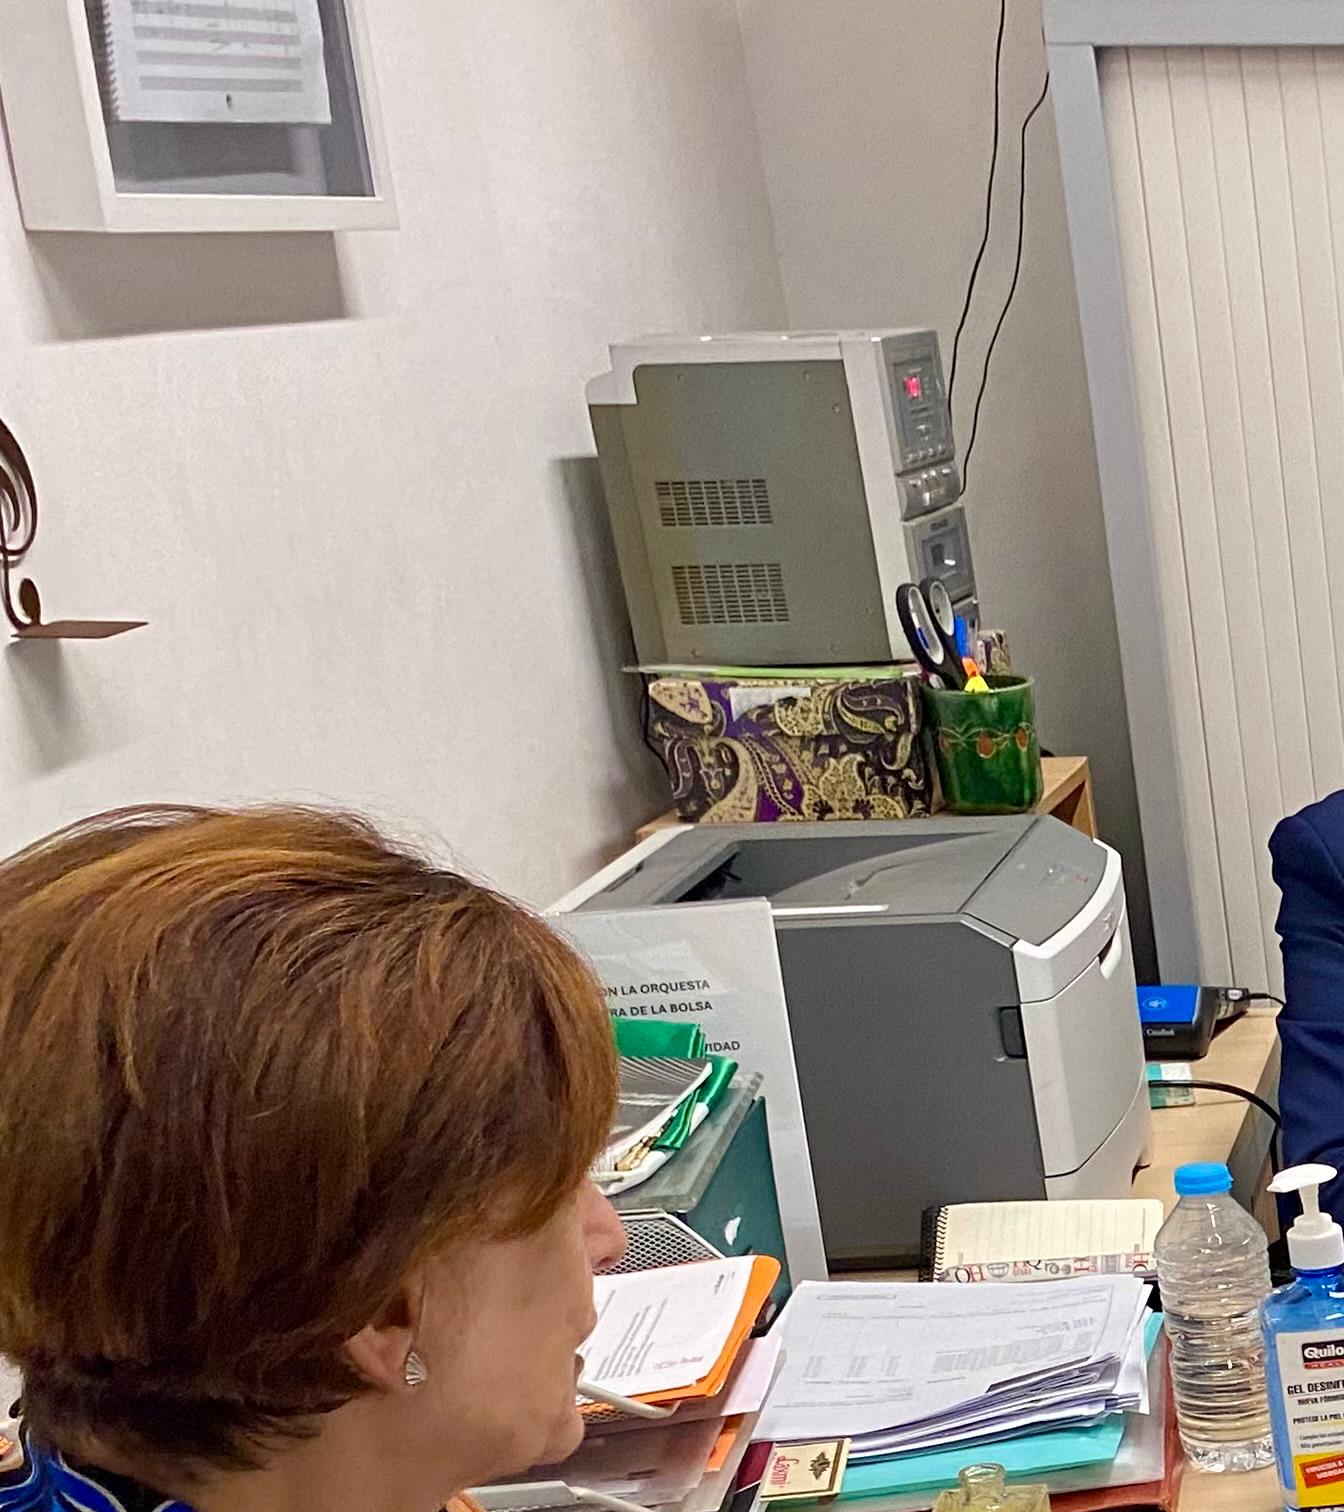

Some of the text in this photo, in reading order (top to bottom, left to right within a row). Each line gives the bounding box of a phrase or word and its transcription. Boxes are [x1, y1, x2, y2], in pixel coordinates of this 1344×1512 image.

[621, 985, 638, 996] LA
[640, 980, 711, 995] ORQUESTA
[631, 1005, 648, 1016] DE
[651, 1004, 667, 1015] LA
[670, 1001, 713, 1014] BOLSA
[1287, 1384, 1305, 1395] GEL
